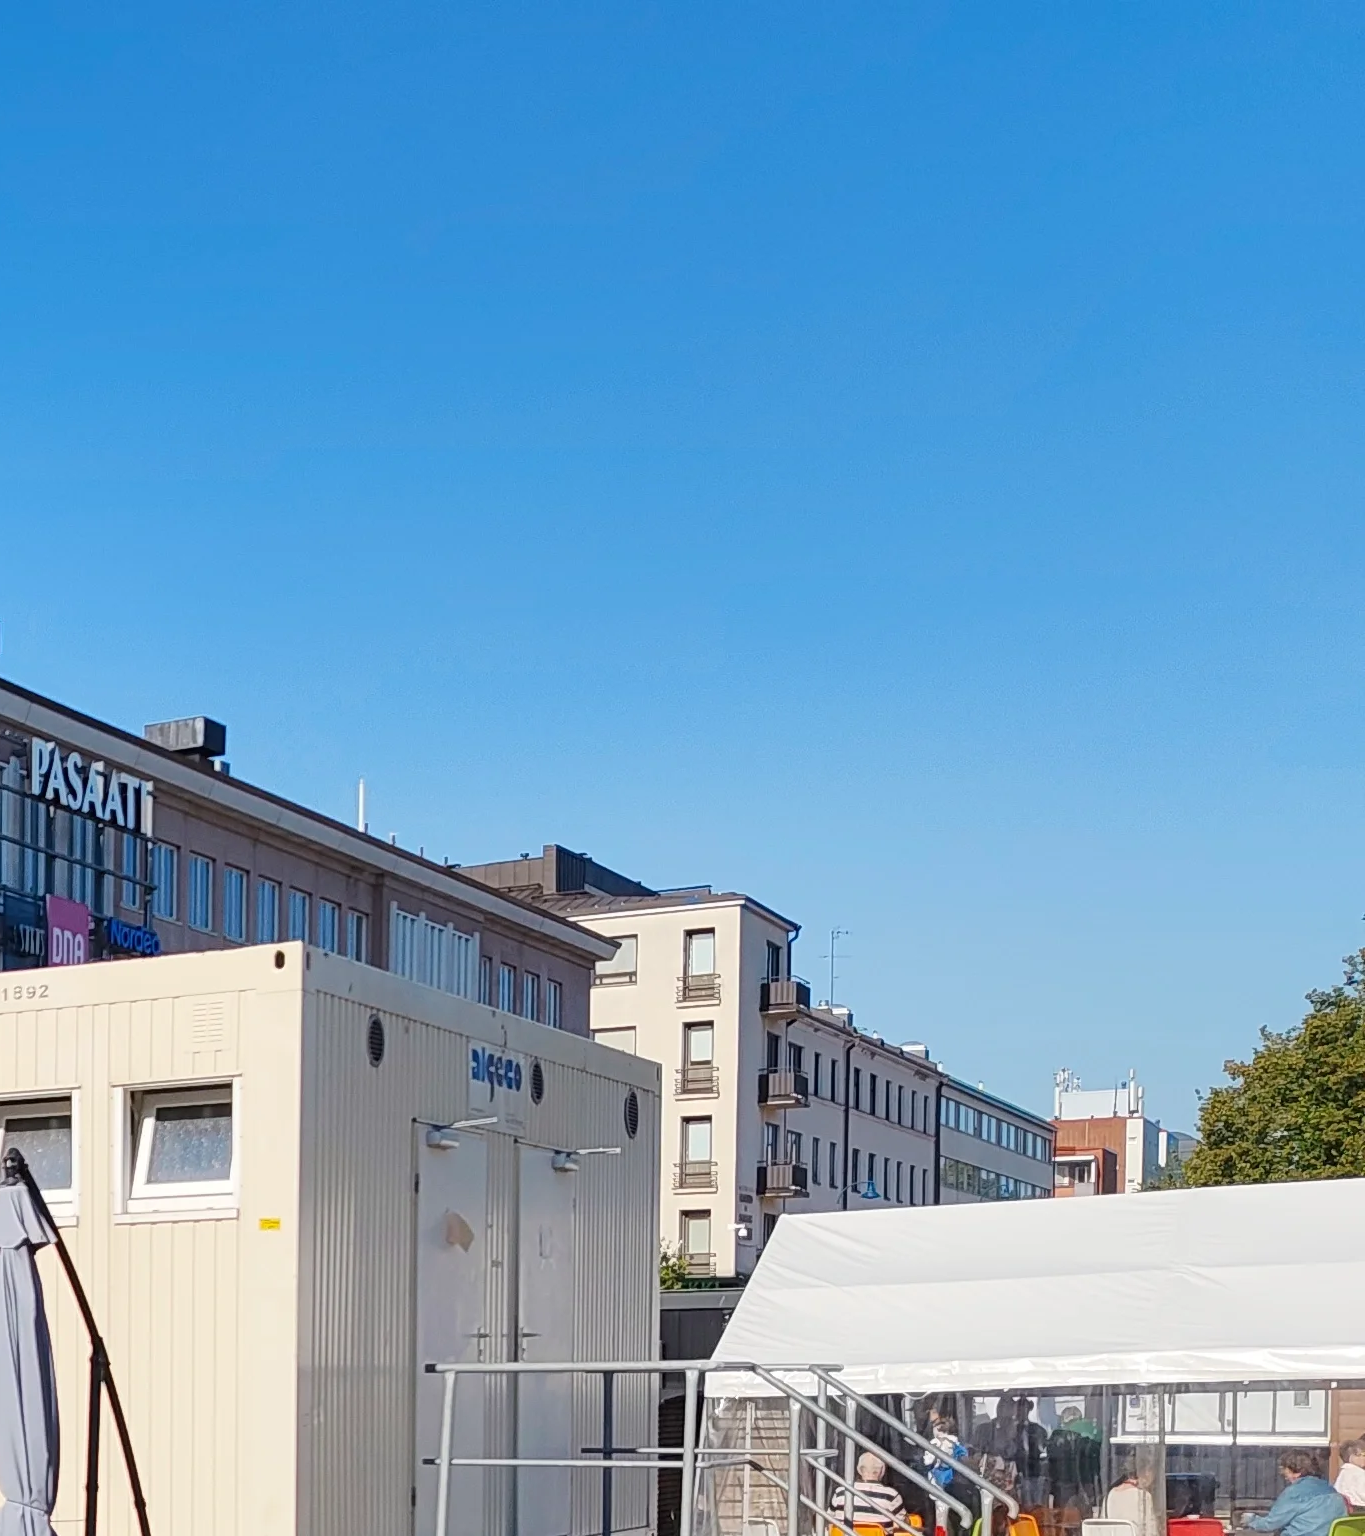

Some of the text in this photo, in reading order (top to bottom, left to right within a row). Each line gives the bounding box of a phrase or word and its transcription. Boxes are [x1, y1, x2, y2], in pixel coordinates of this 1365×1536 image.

[31, 736, 153, 838] PASAATI
[52, 926, 85, 965] DNA
[110, 918, 161, 956] Nordea
[471, 1046, 522, 1103] algeco
